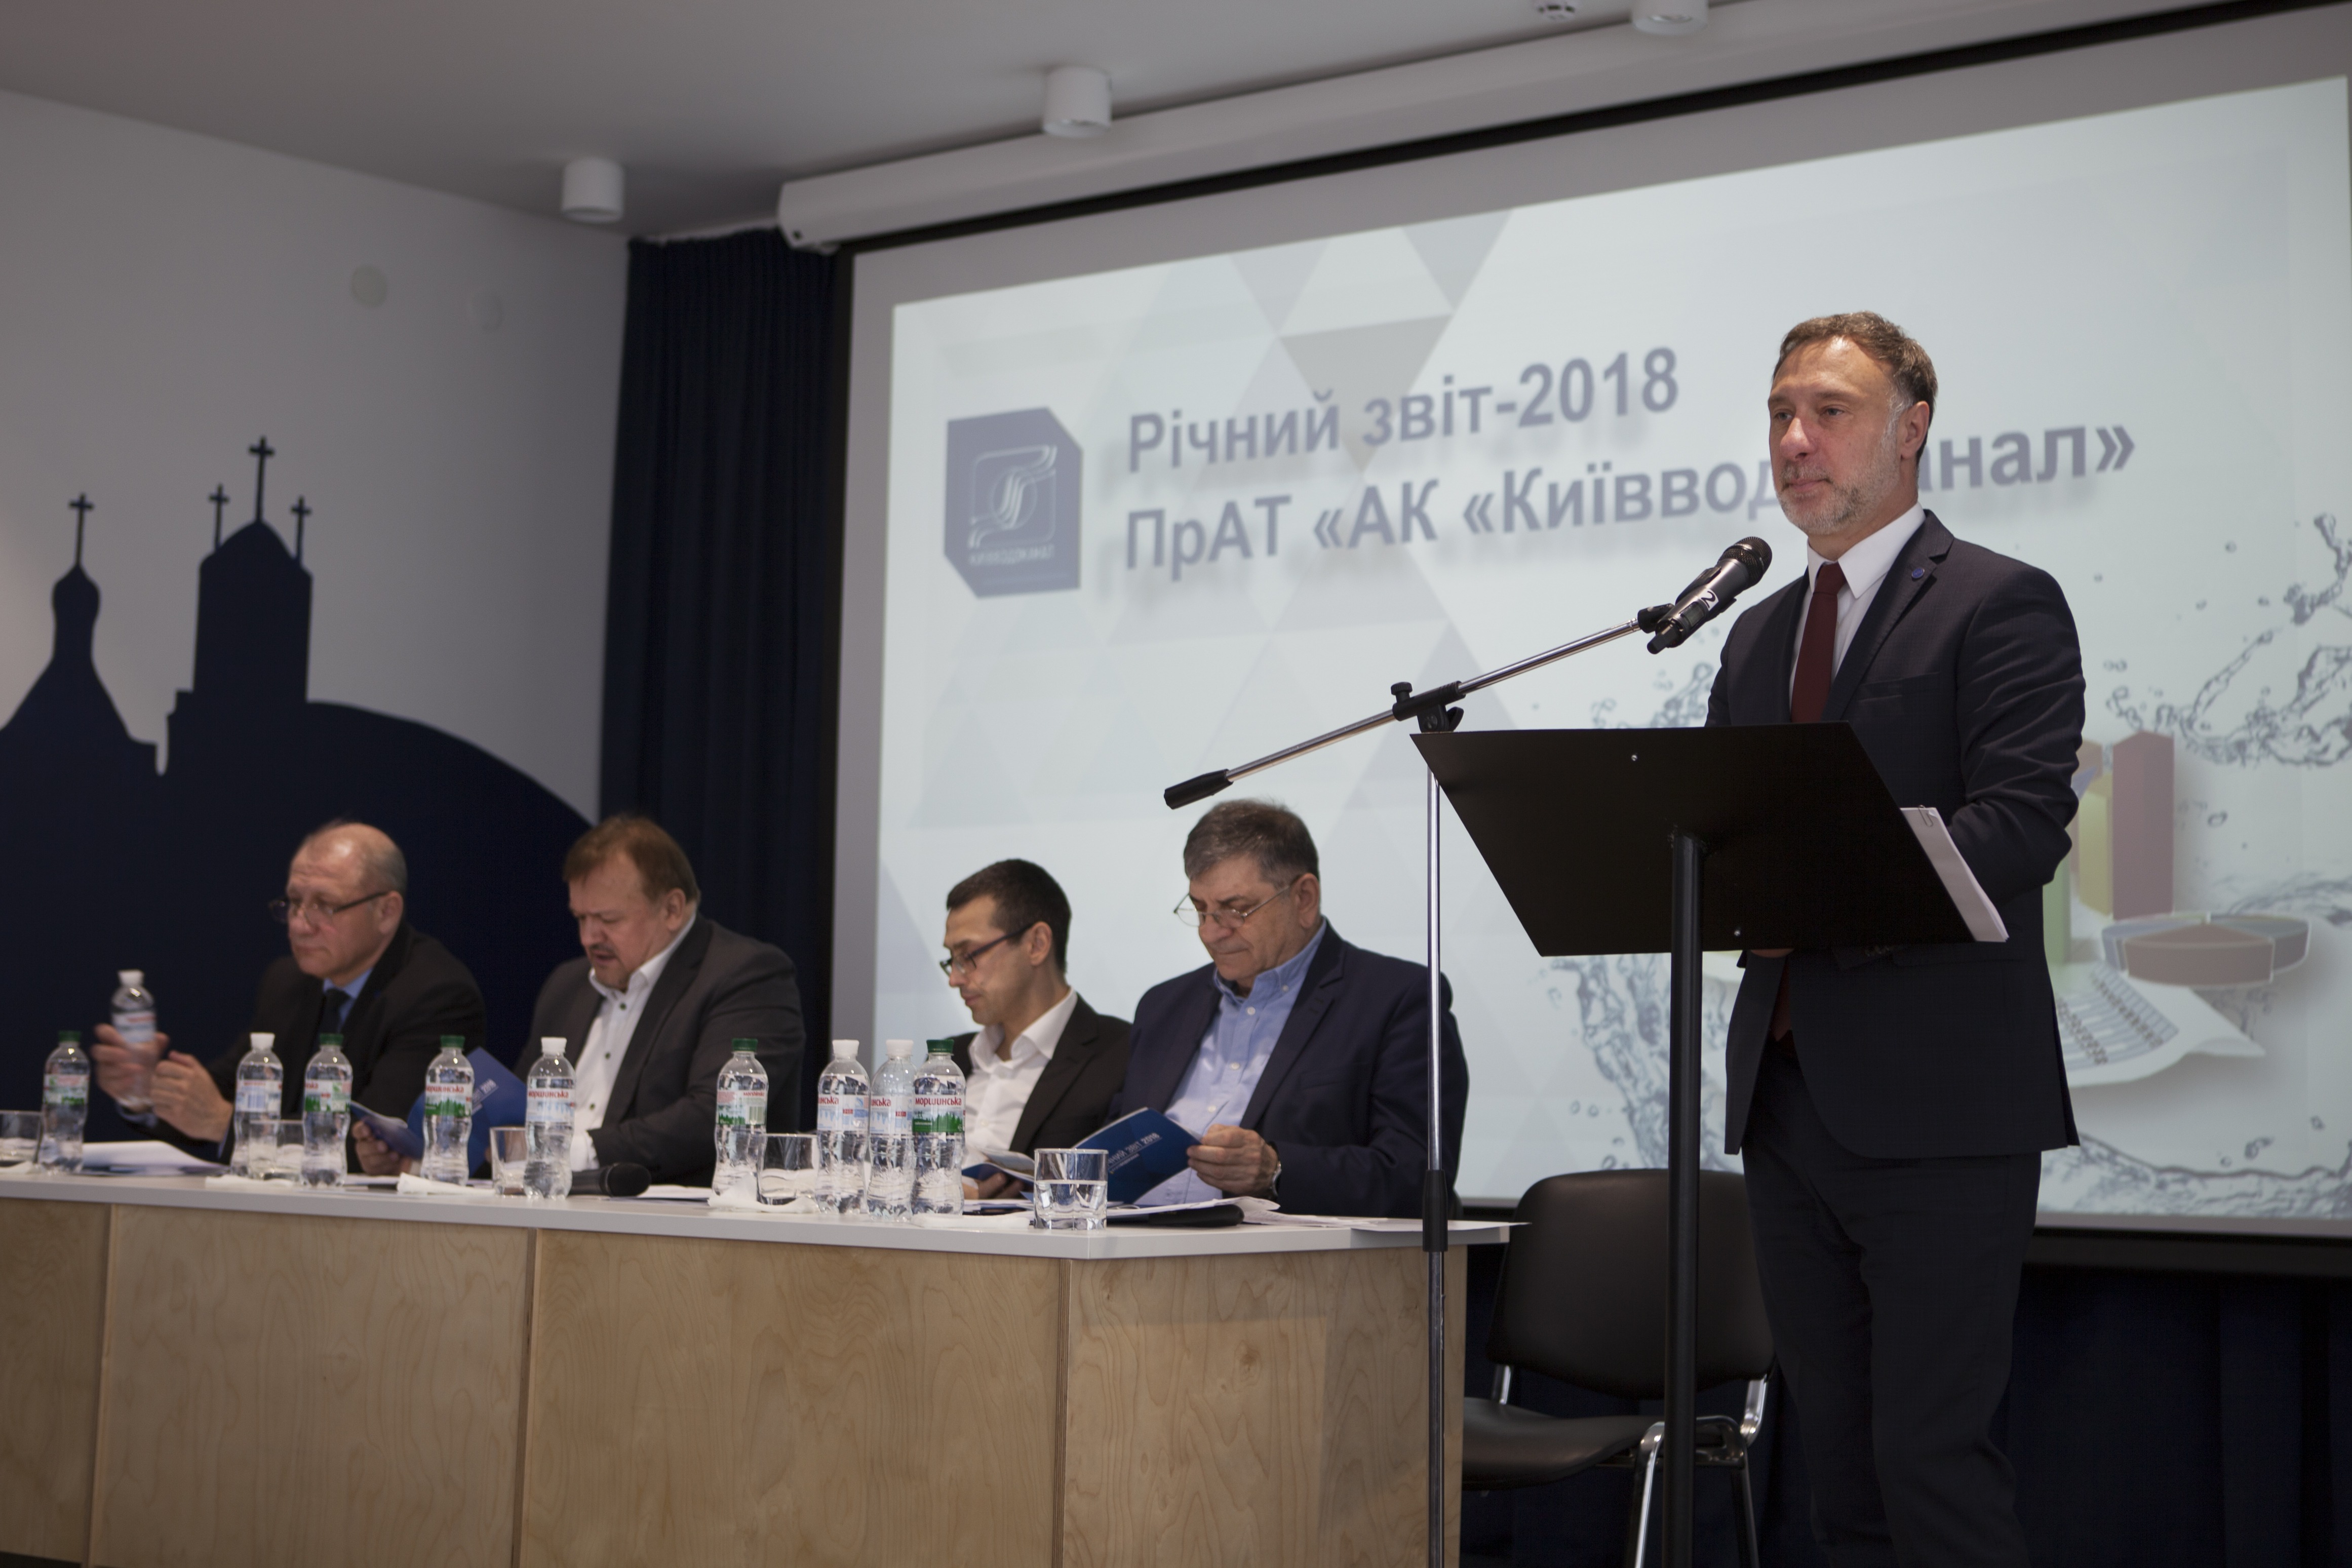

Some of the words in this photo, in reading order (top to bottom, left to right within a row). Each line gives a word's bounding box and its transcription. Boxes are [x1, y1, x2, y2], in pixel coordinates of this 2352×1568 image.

[1128, 388, 1341, 474] Річний
[1360, 347, 1678, 449] звіт-2018
[1126, 494, 1292, 582] ПрАТ
[1313, 478, 1438, 550] «АК
[1701, 591, 1716, 608] 2
